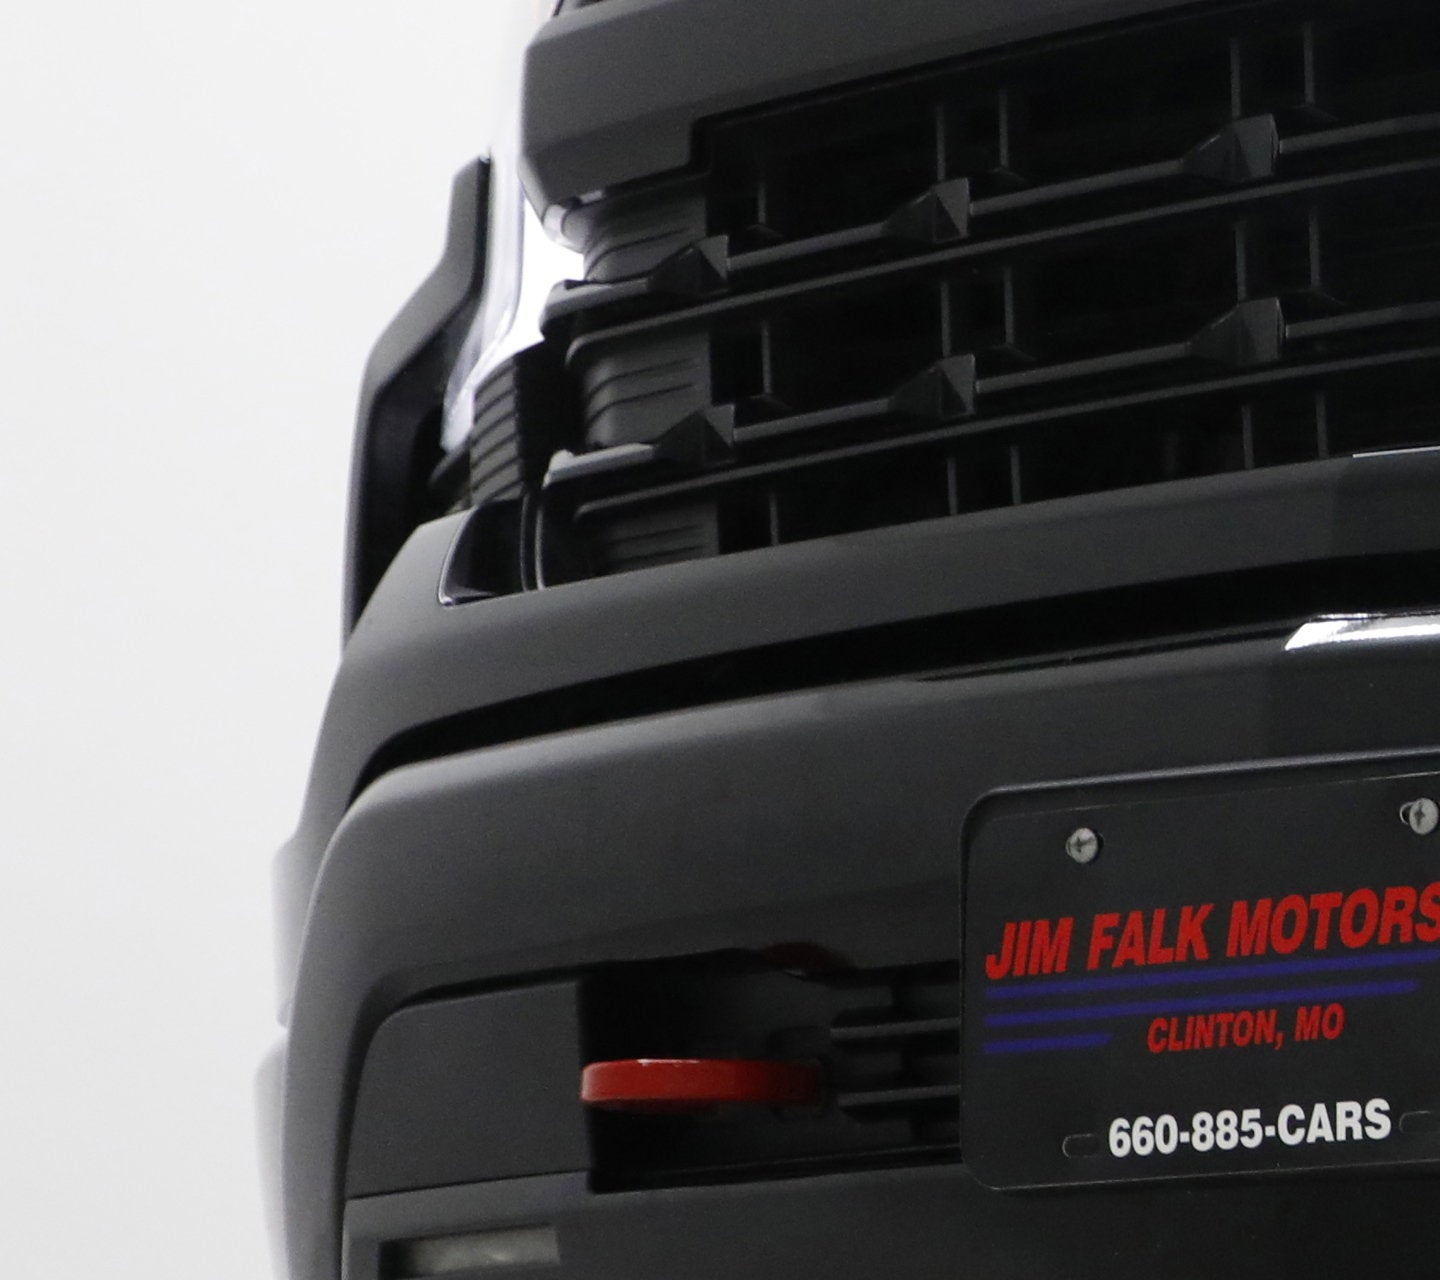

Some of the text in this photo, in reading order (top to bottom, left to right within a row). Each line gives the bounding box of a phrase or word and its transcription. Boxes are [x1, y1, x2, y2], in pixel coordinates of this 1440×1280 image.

[985, 917, 1075, 980] JIM
[1087, 903, 1215, 970] FALK
[1147, 1002, 1345, 1054] CLINTON, MO
[1108, 1098, 1392, 1158] 660-885-CARS
